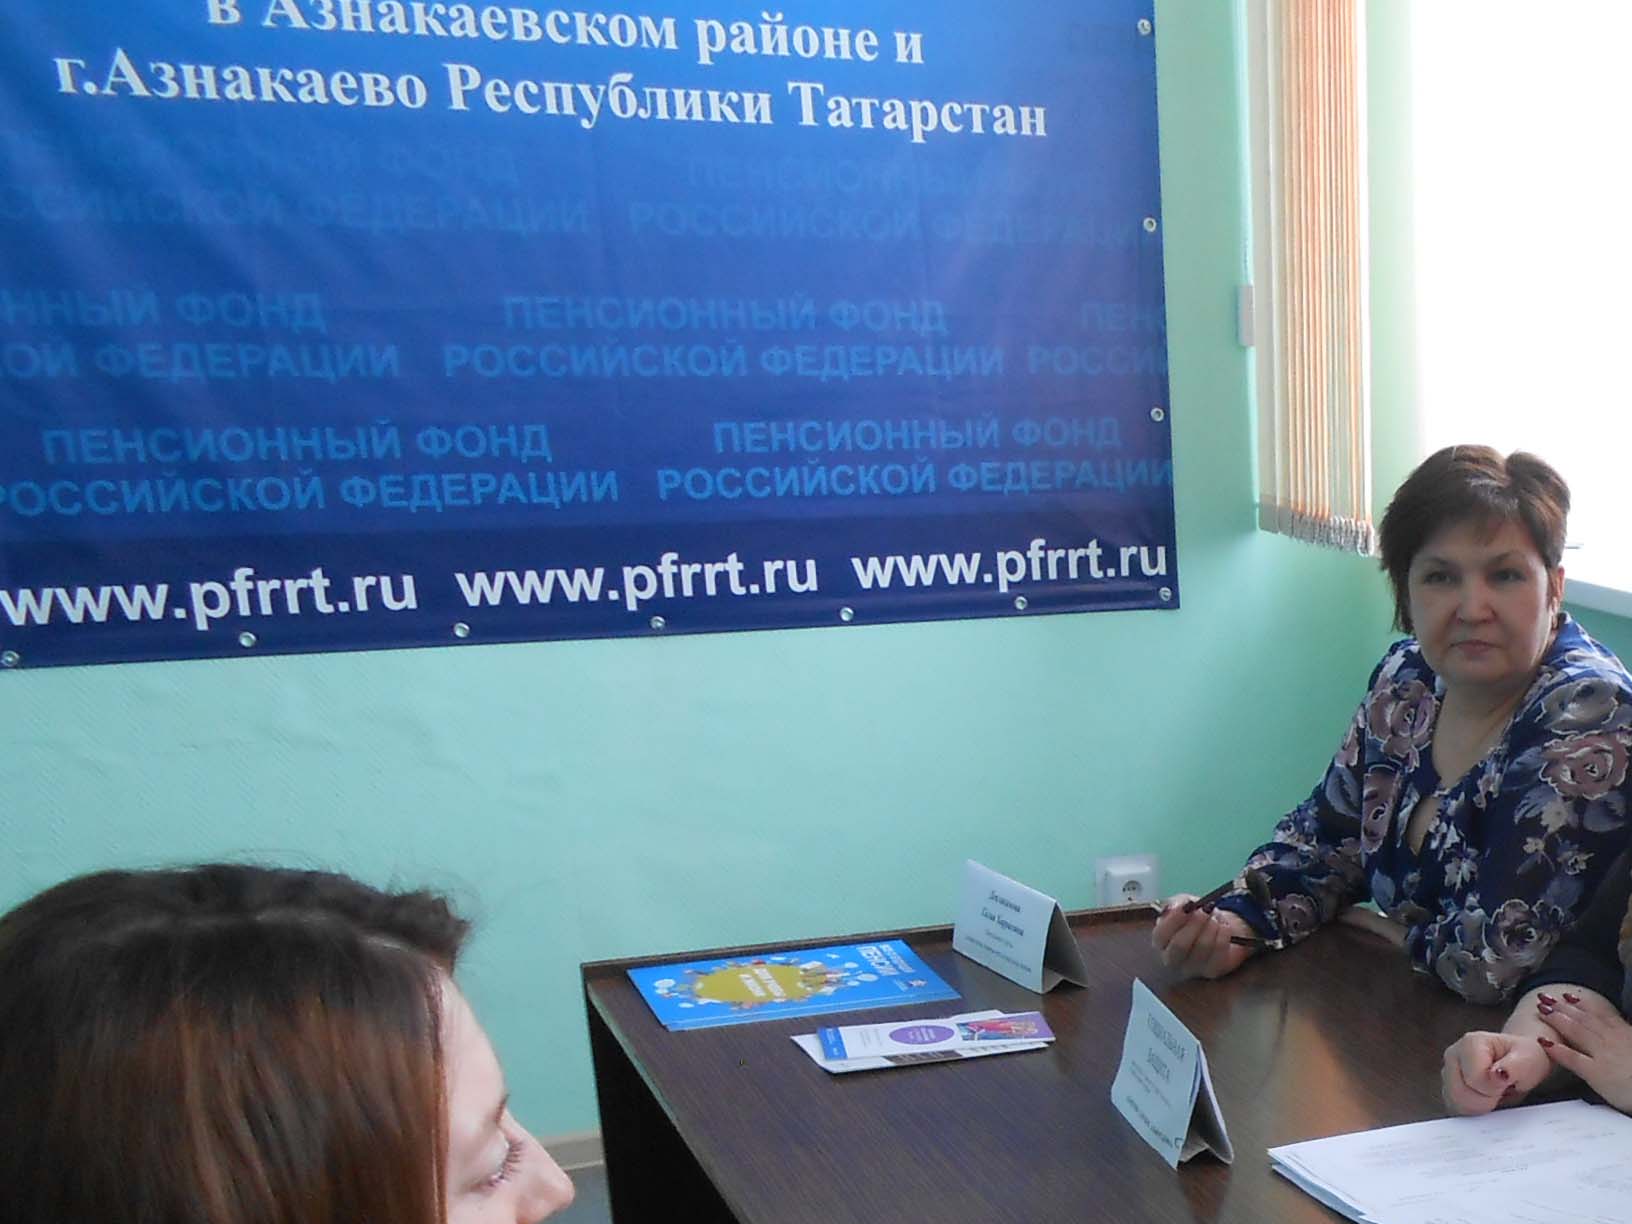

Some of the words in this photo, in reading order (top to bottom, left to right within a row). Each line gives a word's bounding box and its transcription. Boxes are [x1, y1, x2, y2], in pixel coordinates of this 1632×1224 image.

[207, 0, 240, 25] в
[262, 0, 678, 51] Азнакаевском
[694, 10, 880, 65] районе
[893, 31, 925, 65] и
[52, 46, 427, 109] г.Азнакаево
[442, 62, 775, 130] Республики
[786, 80, 1048, 145] Татарстан
[175, 291, 328, 335] ФОНД
[502, 291, 817, 332] ПЕНСИОННЫЙ
[828, 299, 951, 337] ФОНД
[95, 341, 401, 385] ФЕДЕРАЦИИ
[442, 336, 749, 378] РОССИЙСКОЙ
[759, 343, 1006, 382] ФЕДЕРАЦИИ
[41, 416, 402, 466] ПЕНСИОННЫЙ
[415, 424, 554, 464] ФОНД
[712, 411, 1001, 455] ПЕНСИОННЫЙ
[1011, 414, 1123, 451] ФОНД
[0, 468, 327, 518] ОССИЙСКОЙ
[338, 470, 620, 514] ФЕДЕРАЦИИ
[655, 457, 937, 502] РОССИЙСКОЙ
[946, 459, 1173, 497] ФЕДЕРАЦИИ
[455, 551, 818, 611] www.pfrrt.ru
[850, 538, 1168, 594] www.pfrrt.ru
[0, 568, 418, 631] www.pfrrt.ru
